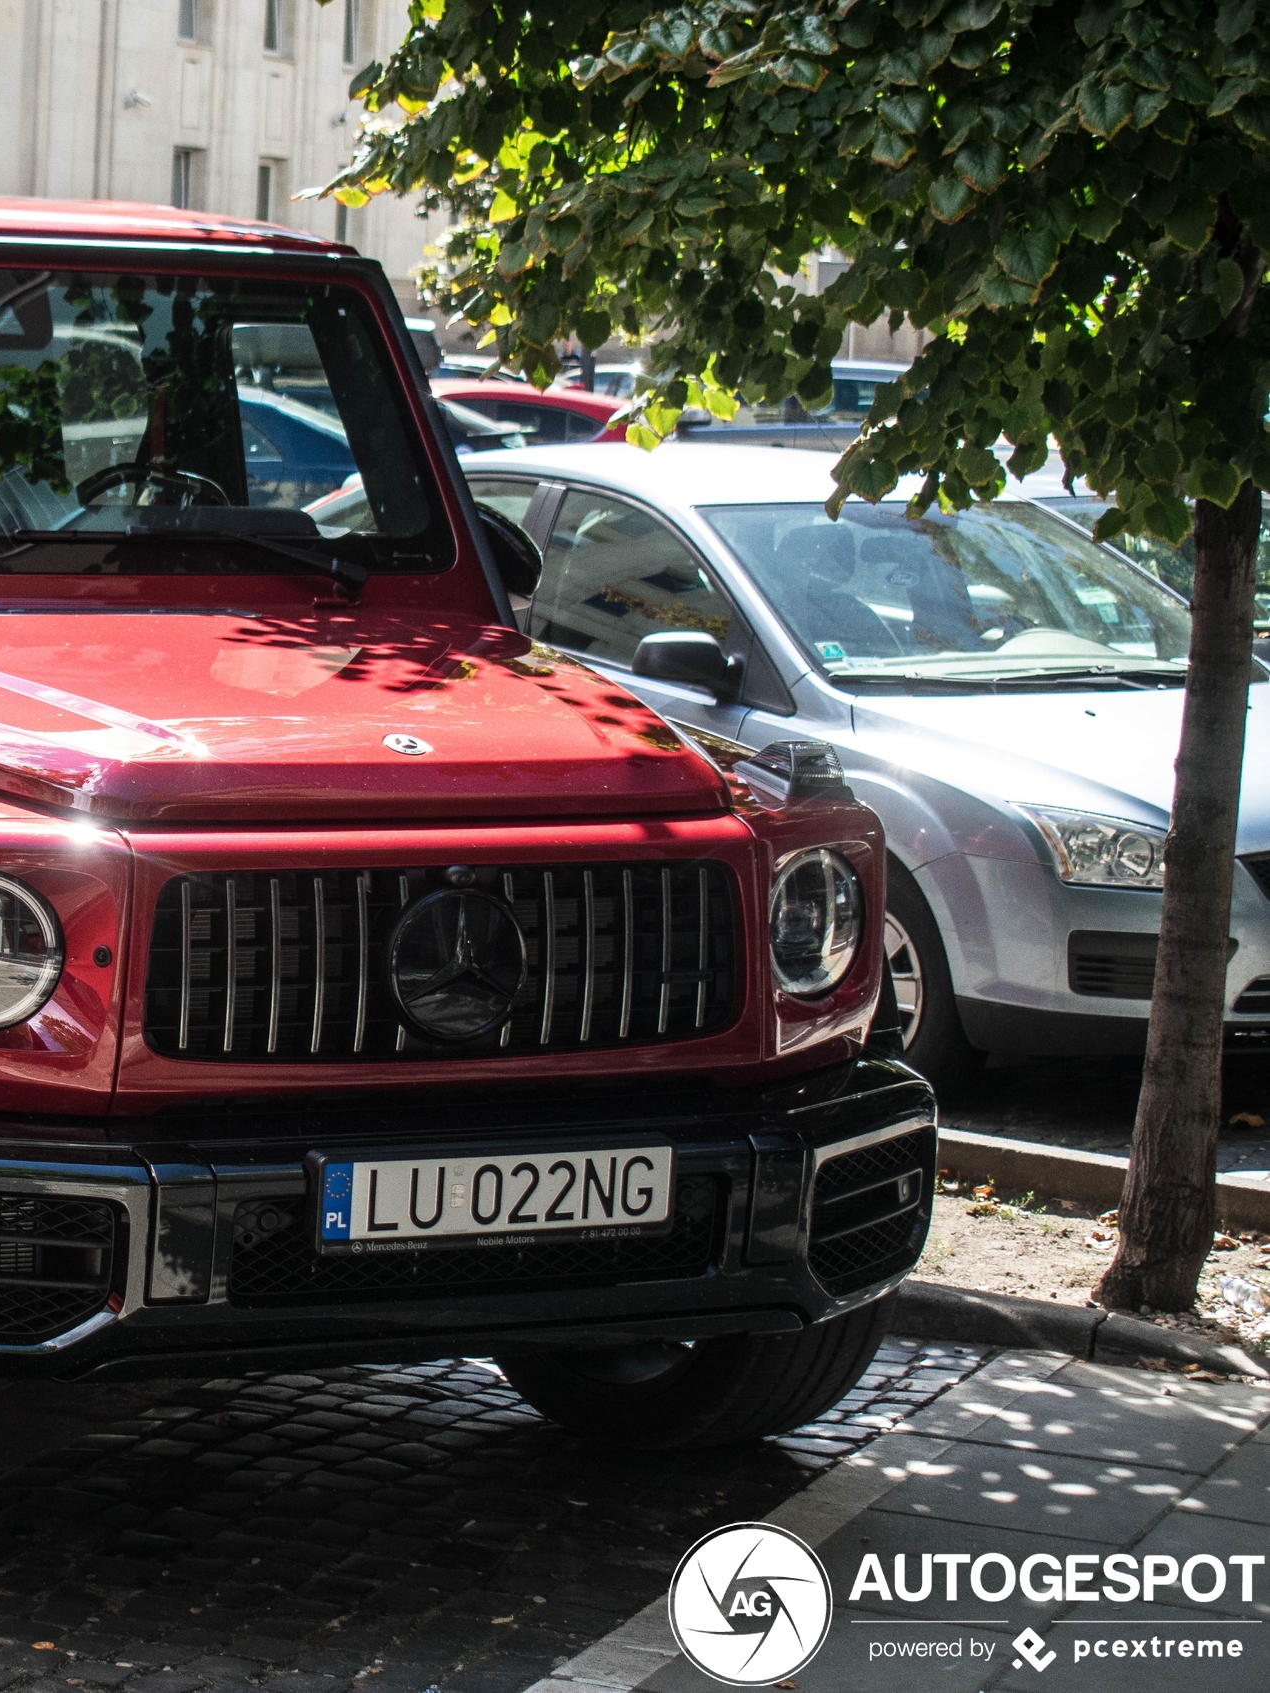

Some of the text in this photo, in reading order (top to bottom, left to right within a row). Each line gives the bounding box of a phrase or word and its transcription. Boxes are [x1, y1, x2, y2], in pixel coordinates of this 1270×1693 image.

[366, 1155, 655, 1232] LU 022NG
[326, 1213, 347, 1229] PL
[365, 1226, 641, 1252] Mercedes-Benz Nobile Motors 81 472 00 00
